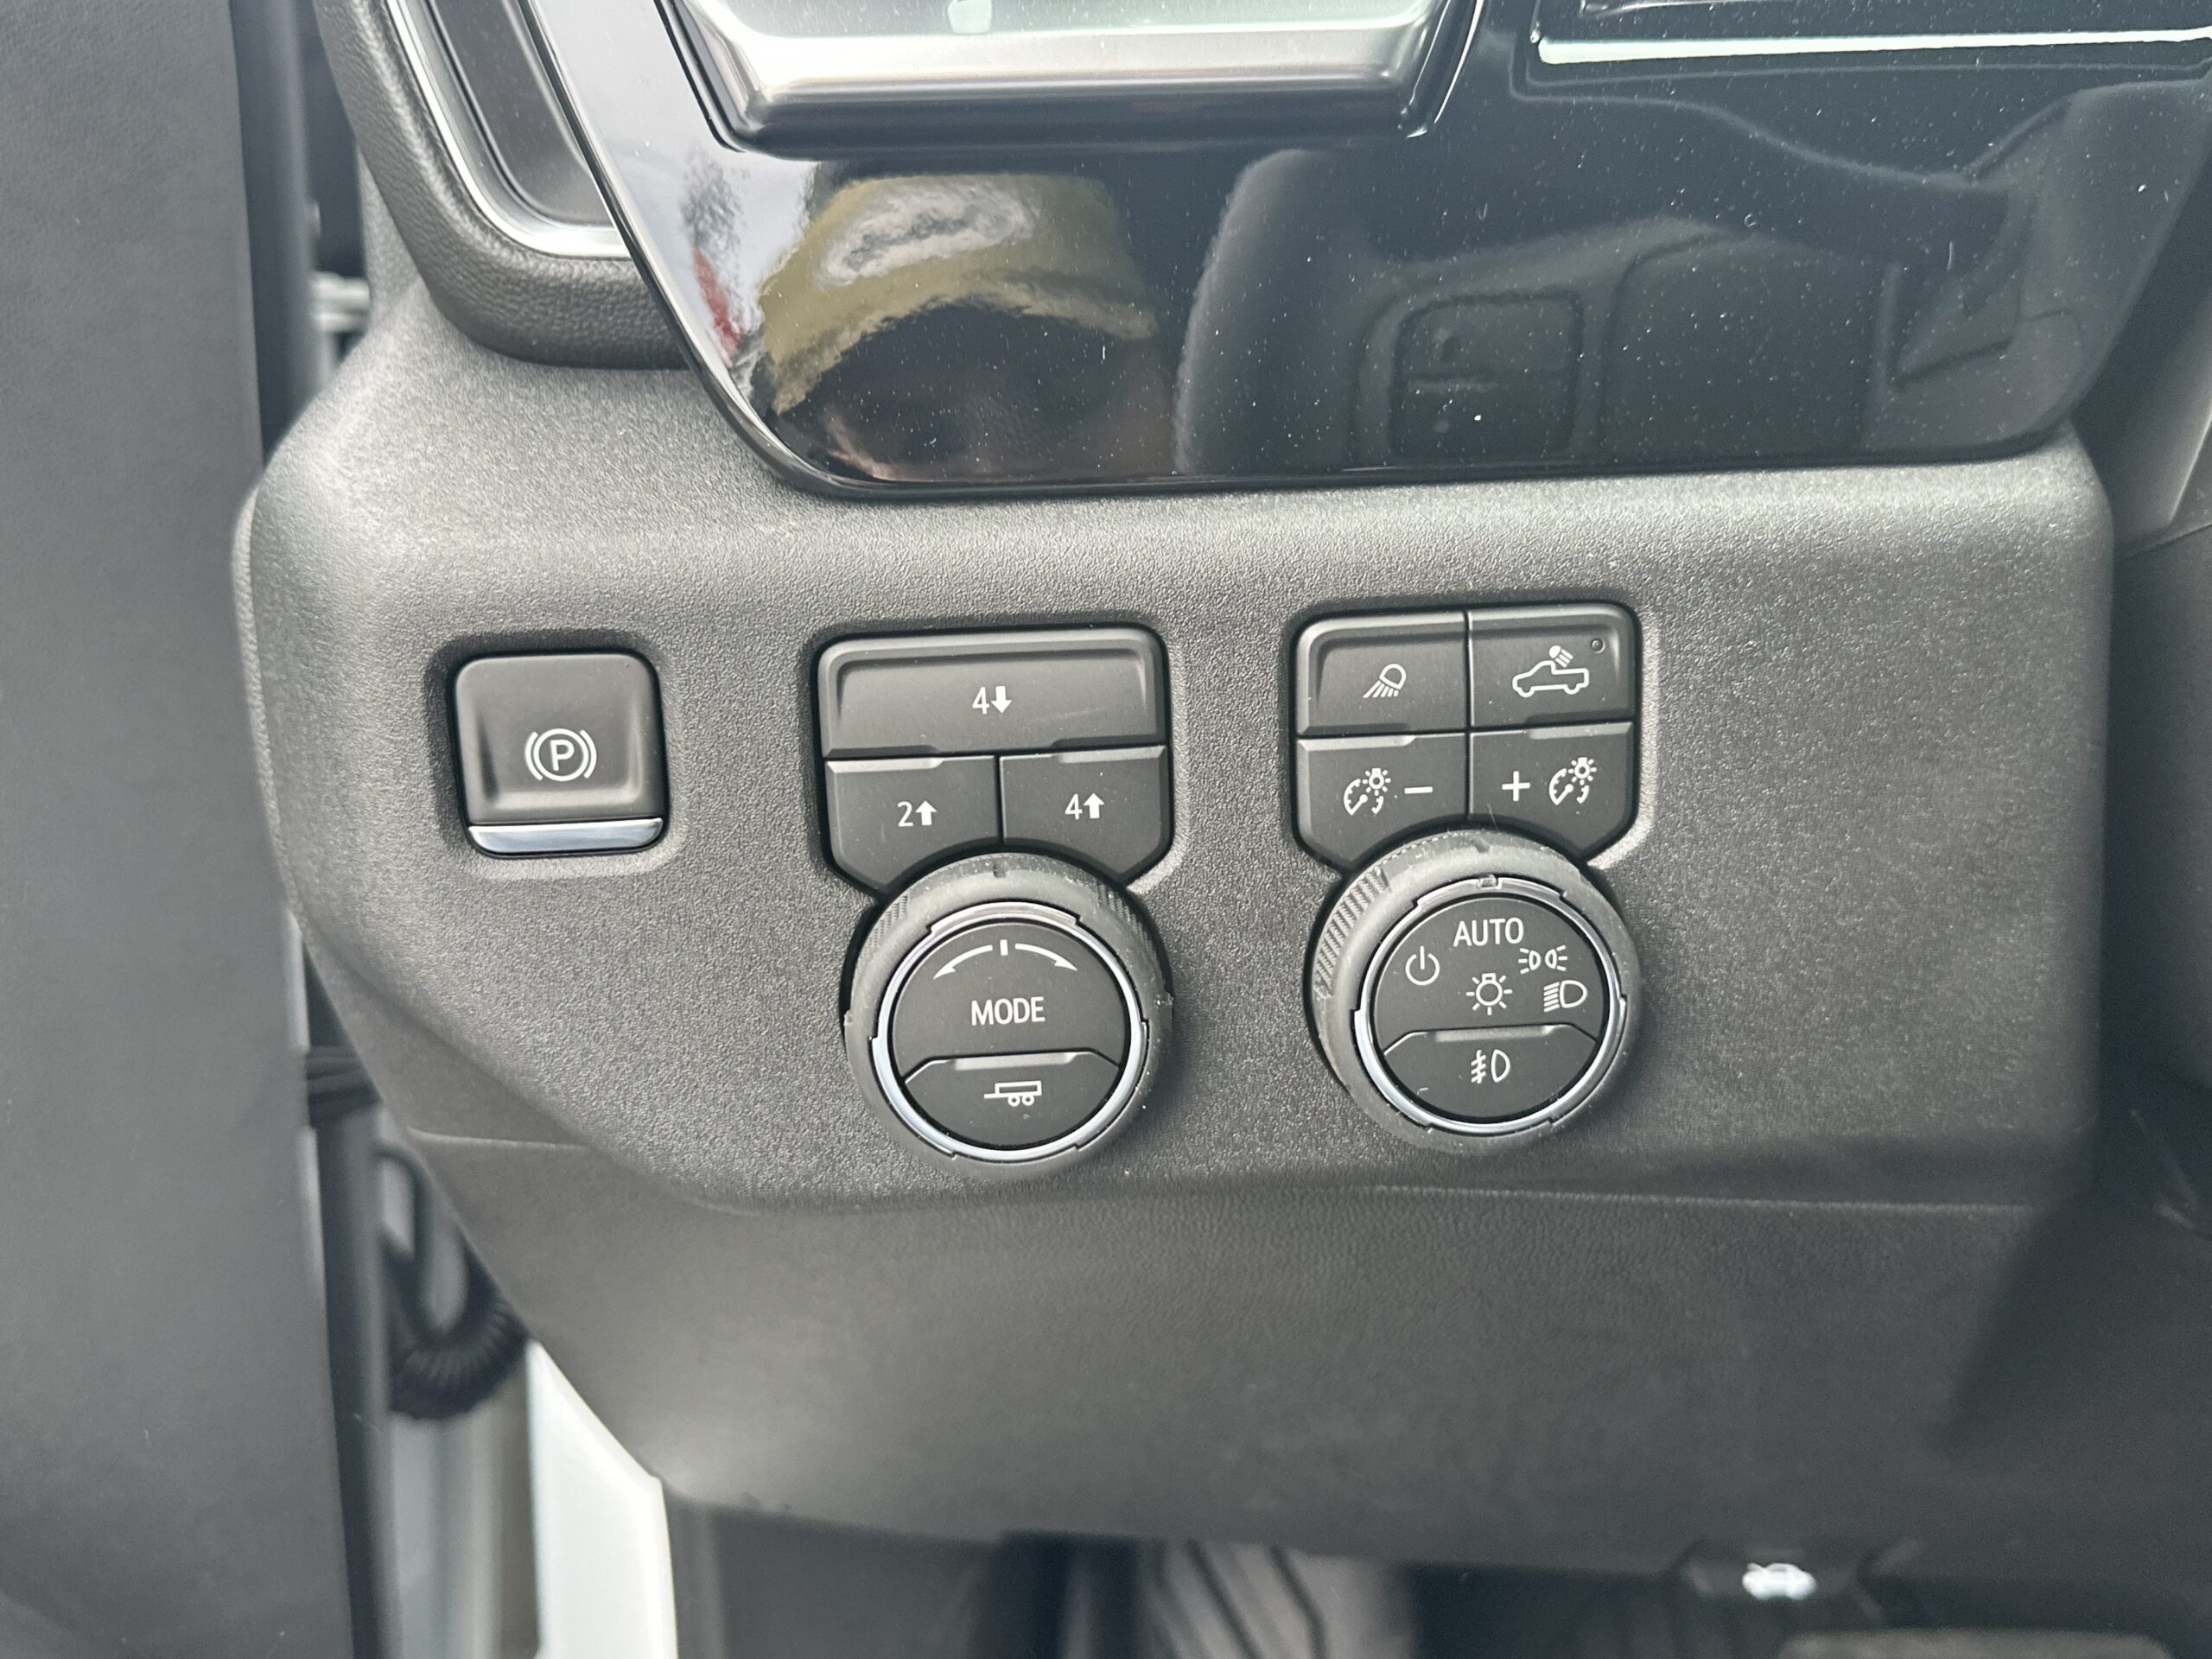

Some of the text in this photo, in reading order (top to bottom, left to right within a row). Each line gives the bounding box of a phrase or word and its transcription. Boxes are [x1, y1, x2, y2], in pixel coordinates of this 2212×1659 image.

[972, 686, 990, 715] 4
[550, 739, 575, 771] P
[897, 801, 914, 827] 2
[1065, 793, 1083, 820] 4
[1453, 917, 1523, 946] AUTO
[970, 997, 1045, 1026] MODE
